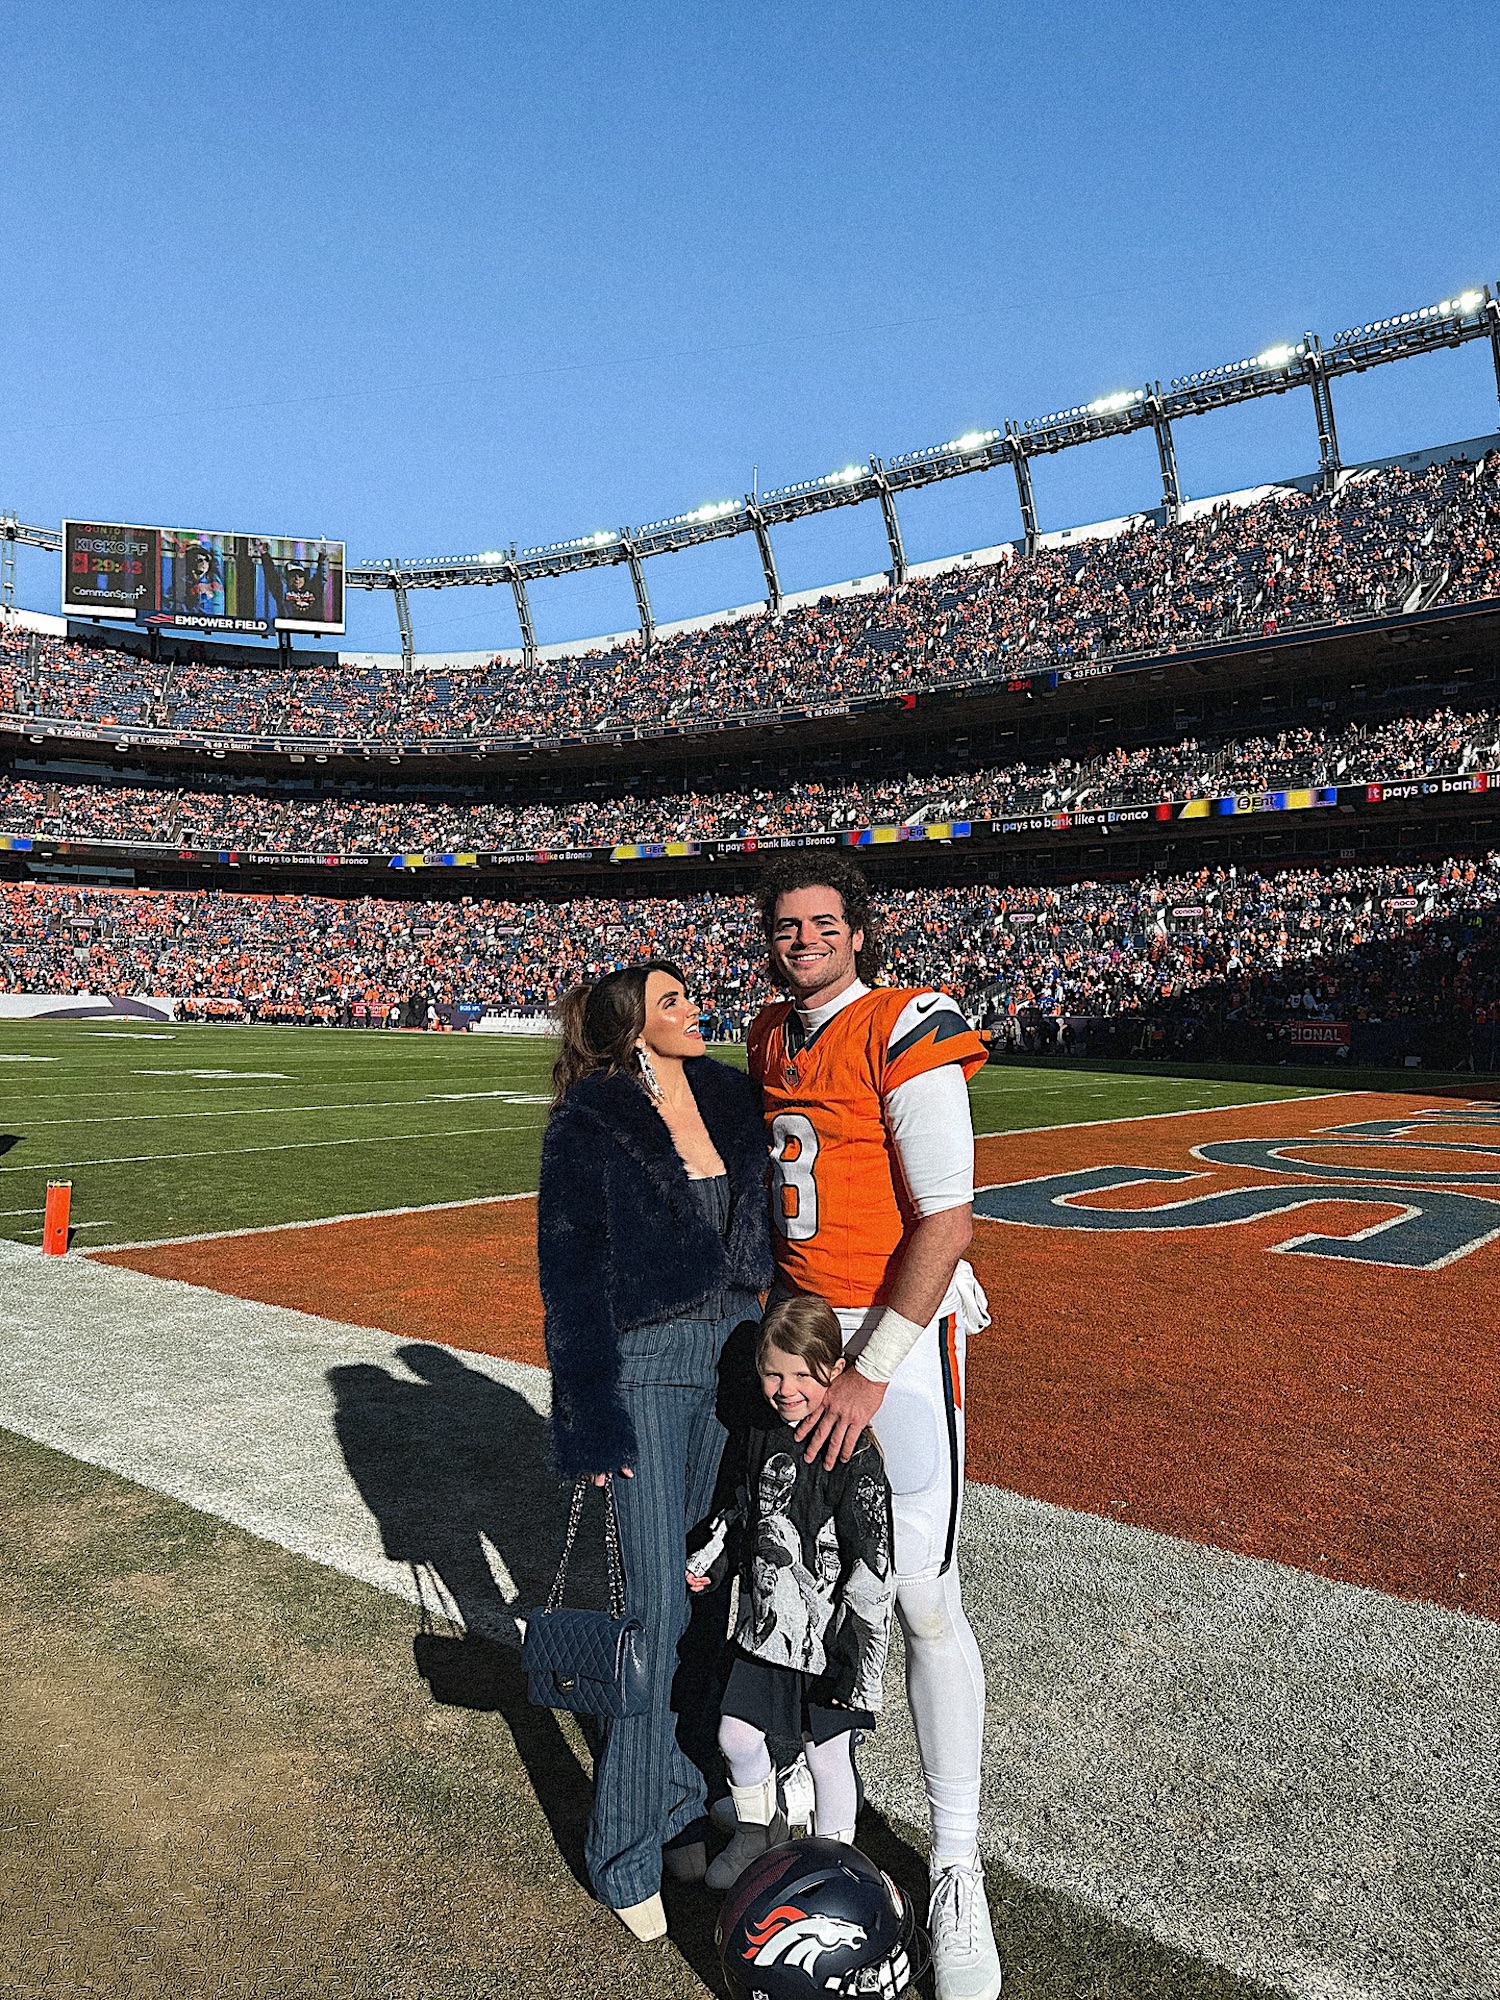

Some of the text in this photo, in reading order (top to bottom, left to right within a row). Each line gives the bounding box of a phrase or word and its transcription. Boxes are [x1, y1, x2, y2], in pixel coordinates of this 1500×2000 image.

[75, 538, 149, 556] KICKOFF
[91, 558, 143, 575] 29:43
[175, 615, 268, 631] EMPOWER FIELD
[1073, 665, 1113, 678] 43 FOLEY
[63, 729, 98, 739] MORTON
[146, 738, 180, 746] JACKSON
[1367, 788, 1380, 798] It
[1382, 785, 1418, 801] pays
[1421, 783, 1438, 793] to
[1442, 777, 1482, 792] bank
[1253, 796, 1274, 807] Ent
[992, 810, 1148, 833] It pays to bank like a Bronco
[717, 843, 724, 851] It
[725, 843, 745, 852] pays
[746, 841, 756, 850] to
[757, 839, 779, 849] bank
[780, 838, 796, 847] like
[805, 836, 836, 846] Bronco
[249, 854, 257, 863] It
[257, 855, 280, 865] pays
[281, 856, 291, 864] to
[292, 856, 316, 864] bank
[316, 856, 333, 864] like
[340, 857, 369, 865] Bronco
[490, 855, 497, 863] It
[498, 855, 515, 864] pays
[516, 854, 524, 862] to
[565, 851, 592, 860] Bronco
[769, 1112, 819, 1242] 8
